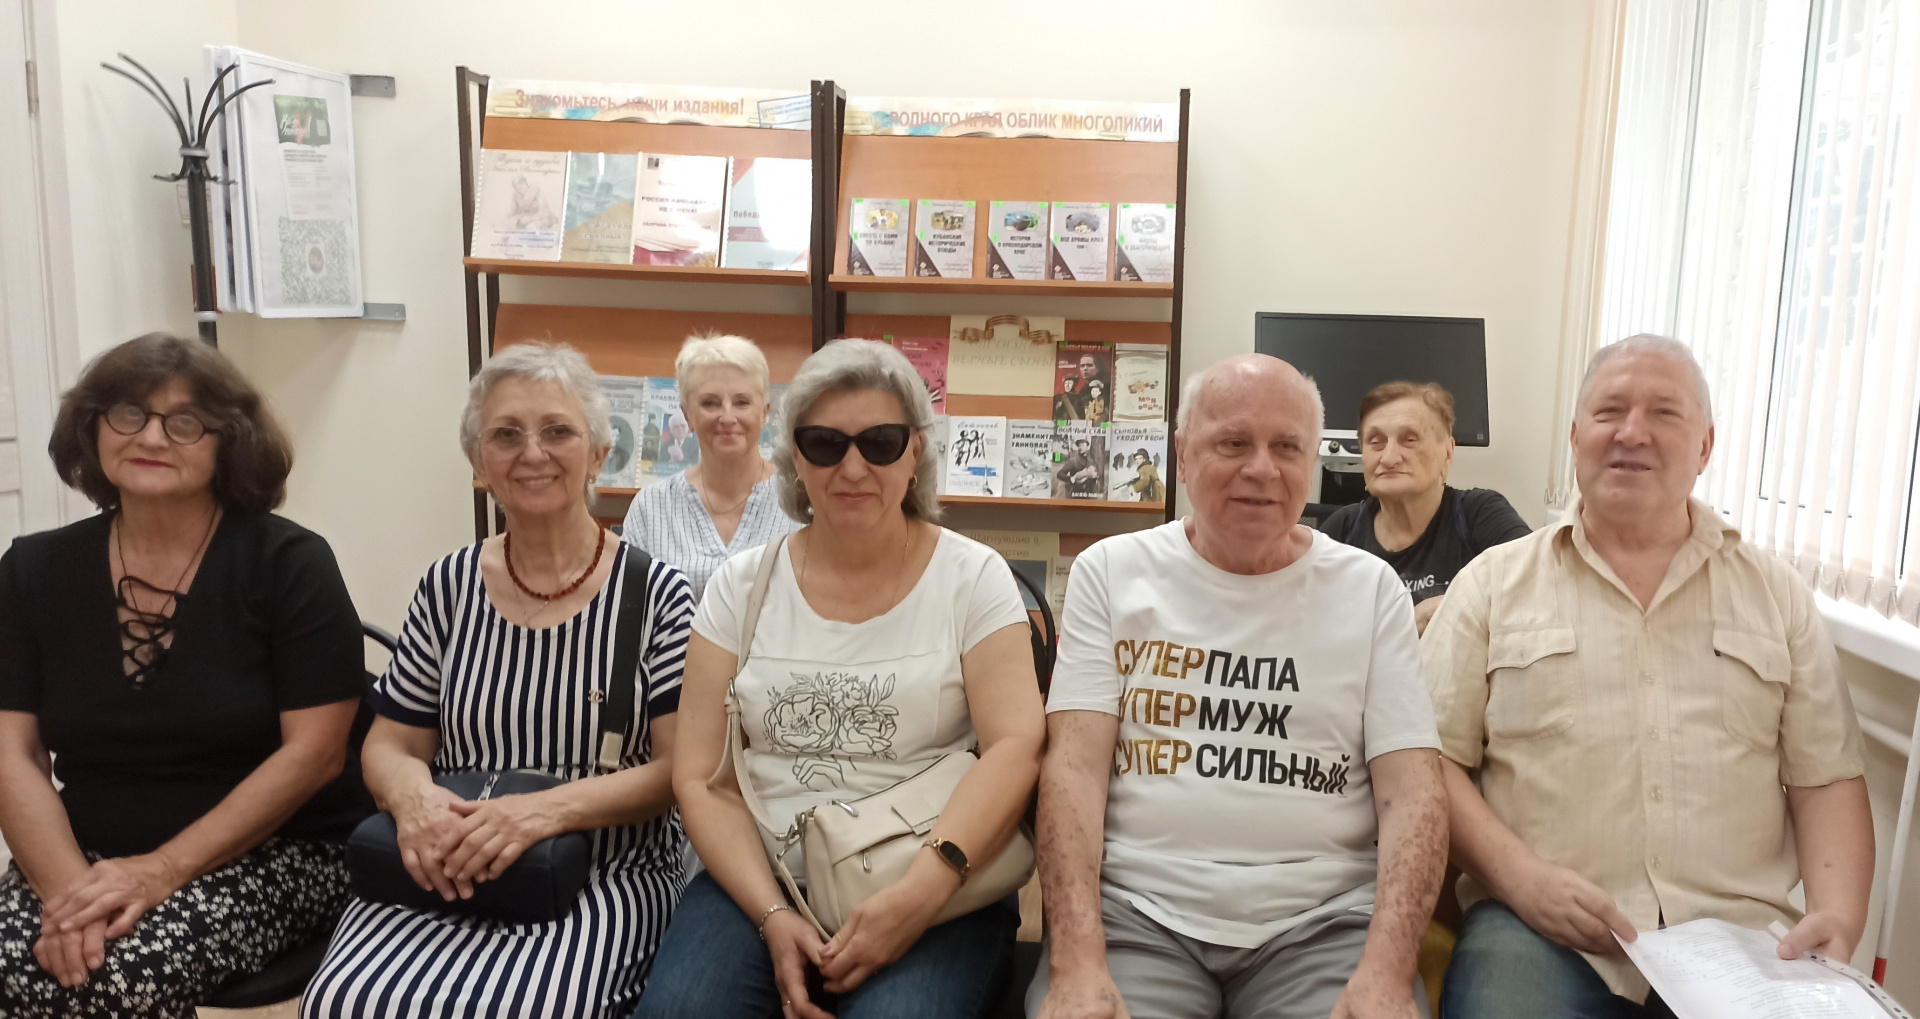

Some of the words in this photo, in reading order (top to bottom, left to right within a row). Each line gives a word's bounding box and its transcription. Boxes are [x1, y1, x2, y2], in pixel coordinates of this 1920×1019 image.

[624, 96, 669, 113] наши
[672, 97, 745, 116] издания!
[889, 110, 961, 127] РОДНОГО
[963, 111, 1003, 127] КРАЯ
[1006, 112, 1058, 129] ОБЛИК
[1060, 114, 1164, 134] МНОГОЛИКИЙ
